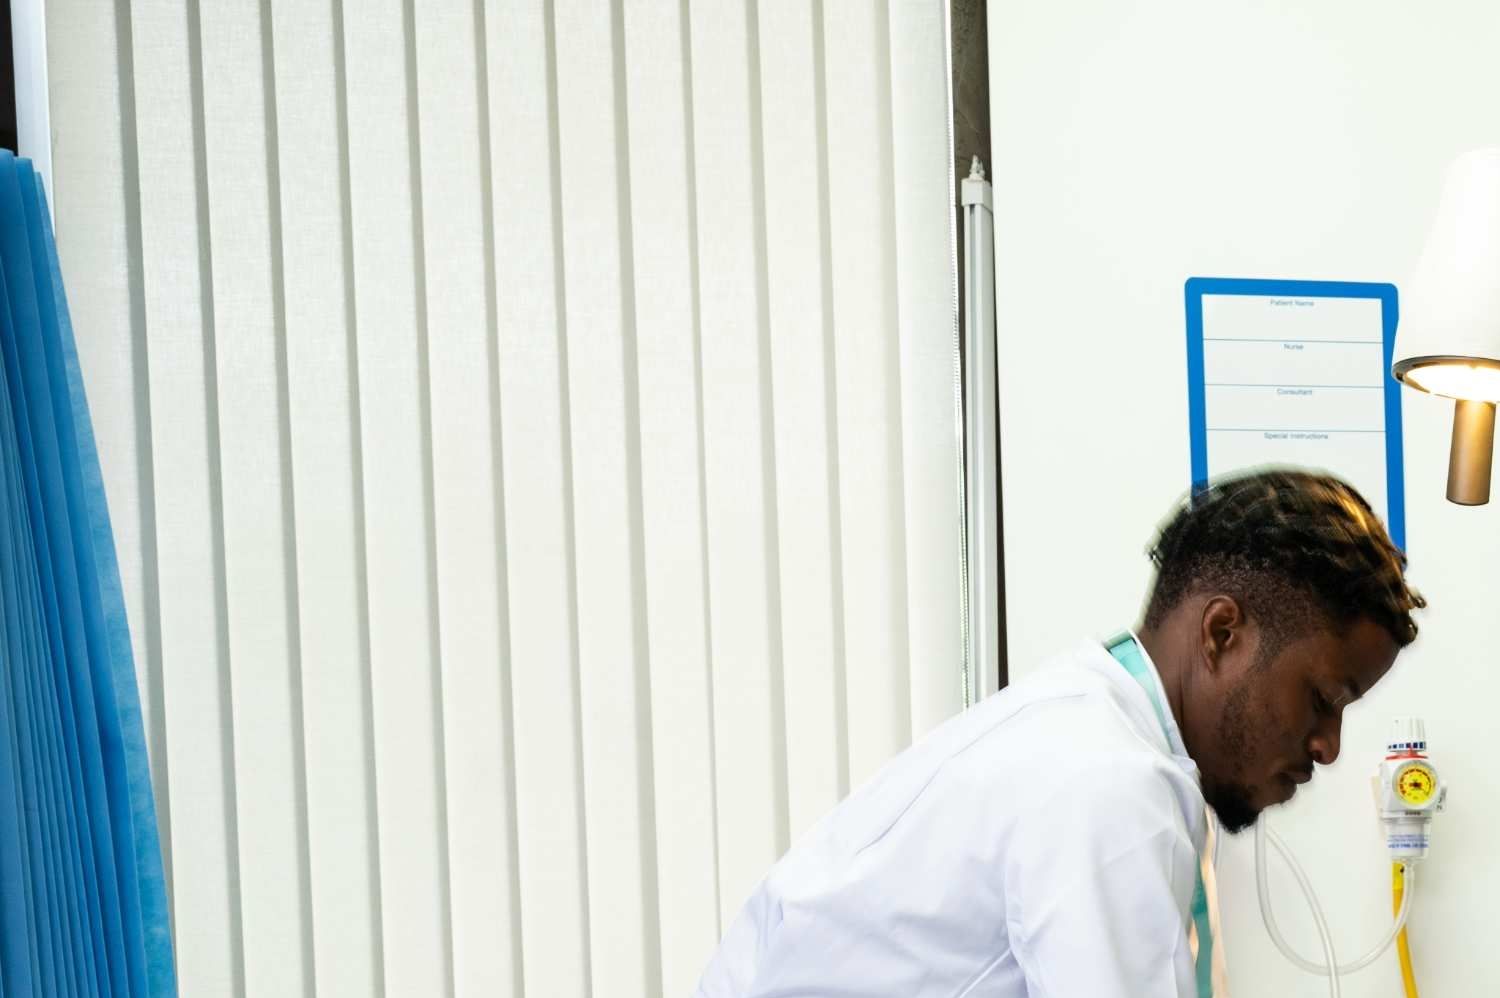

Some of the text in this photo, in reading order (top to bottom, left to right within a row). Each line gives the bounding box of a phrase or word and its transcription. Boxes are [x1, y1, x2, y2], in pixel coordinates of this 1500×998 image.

[1270, 299, 1315, 307] Patient Name
[1276, 387, 1313, 396] Consultant
[1263, 431, 1289, 441] Special
